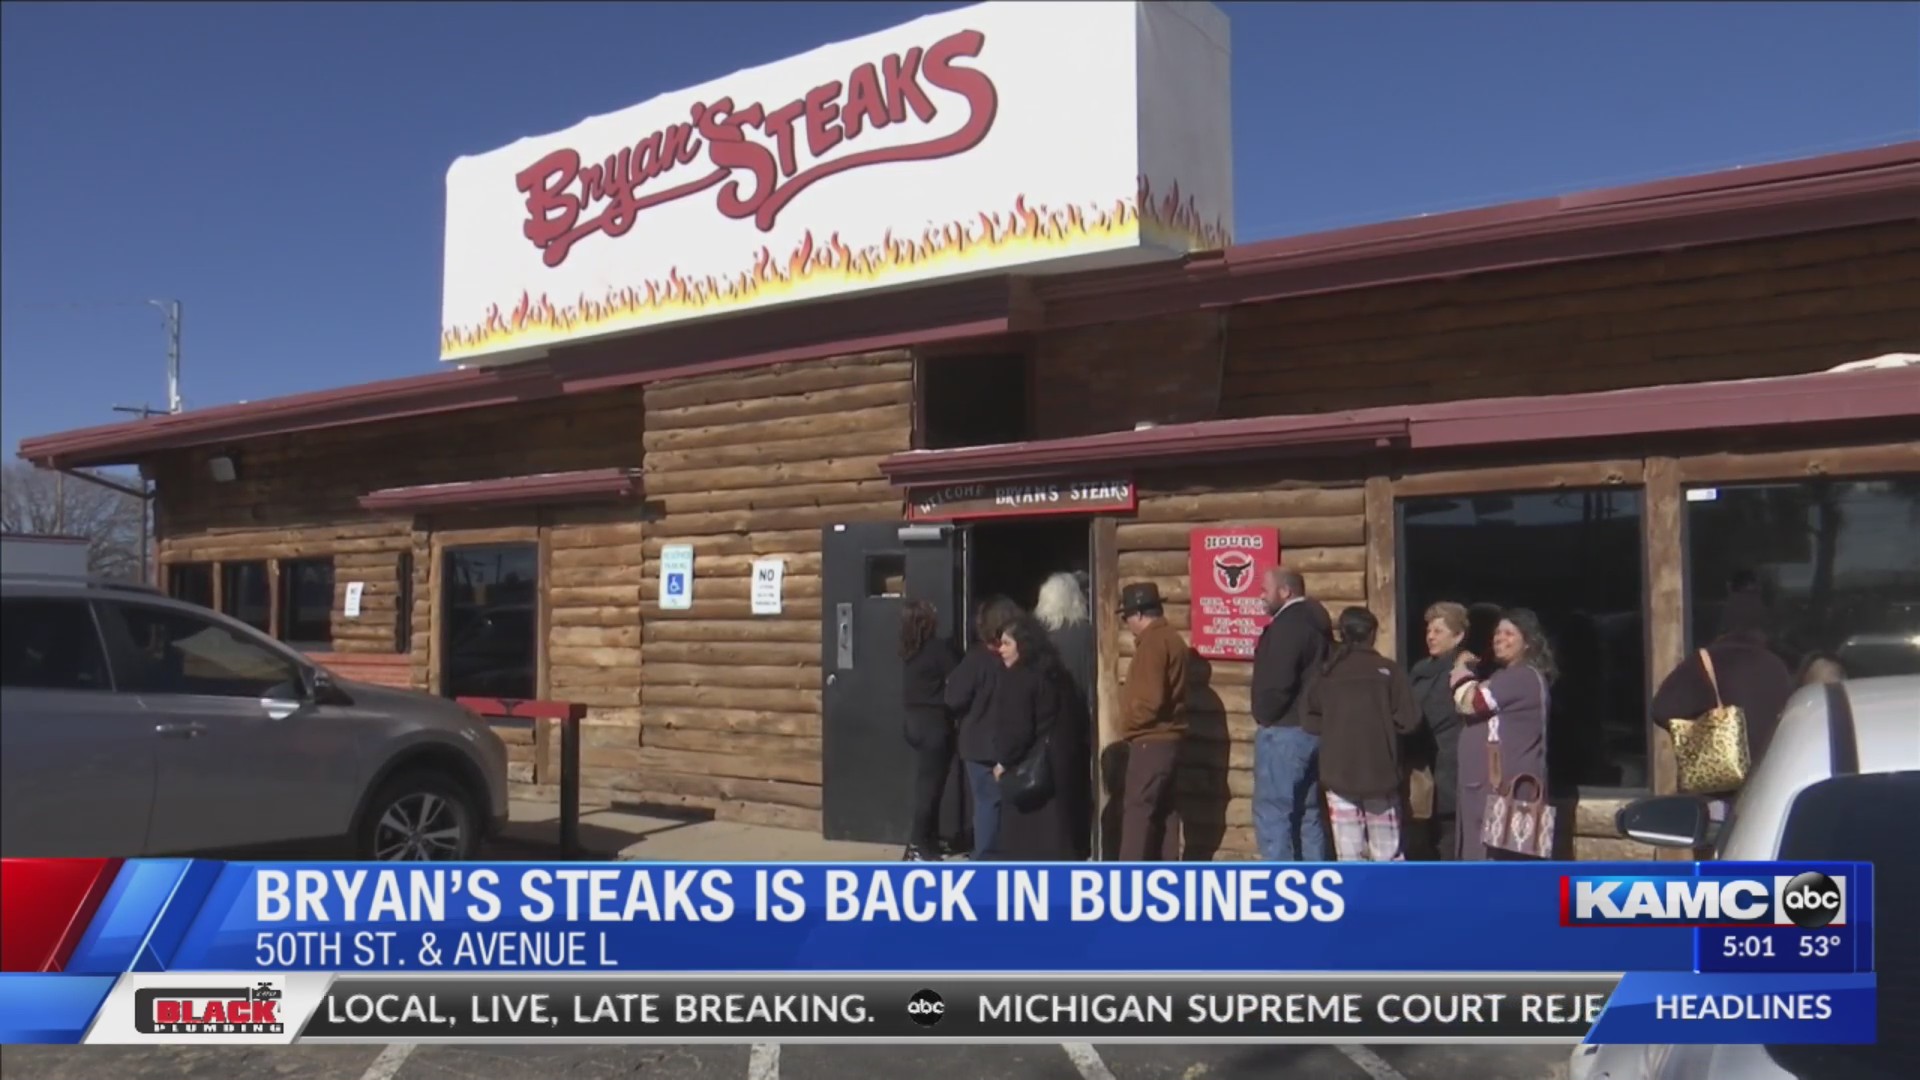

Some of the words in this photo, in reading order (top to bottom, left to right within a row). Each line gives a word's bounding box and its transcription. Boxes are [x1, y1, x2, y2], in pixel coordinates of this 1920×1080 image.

[515, 96, 735, 267] Bryan's
[716, 29, 998, 232] STEAKS
[1070, 480, 1130, 501] STEAKS
[1205, 535, 1263, 550] HOURS
[759, 569, 775, 582] NO
